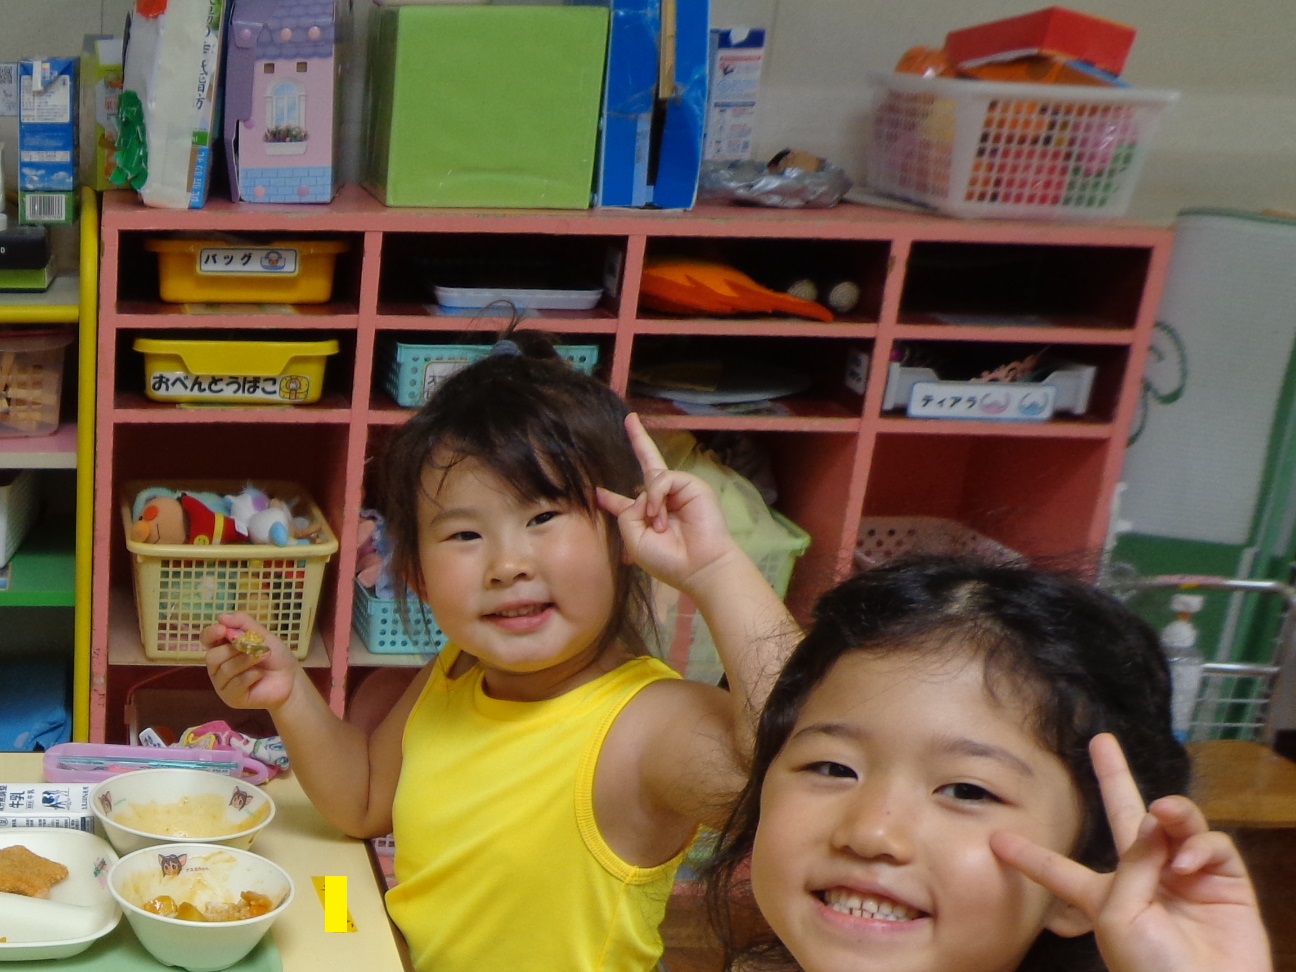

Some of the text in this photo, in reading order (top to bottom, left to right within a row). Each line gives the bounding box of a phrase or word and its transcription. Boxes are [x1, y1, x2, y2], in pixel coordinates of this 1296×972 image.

[204, 252, 253, 266] バッグ
[151, 375, 278, 396] おべんとうばこ
[920, 394, 978, 409] ティアラ
[9, 790, 25, 808] 牛乳
